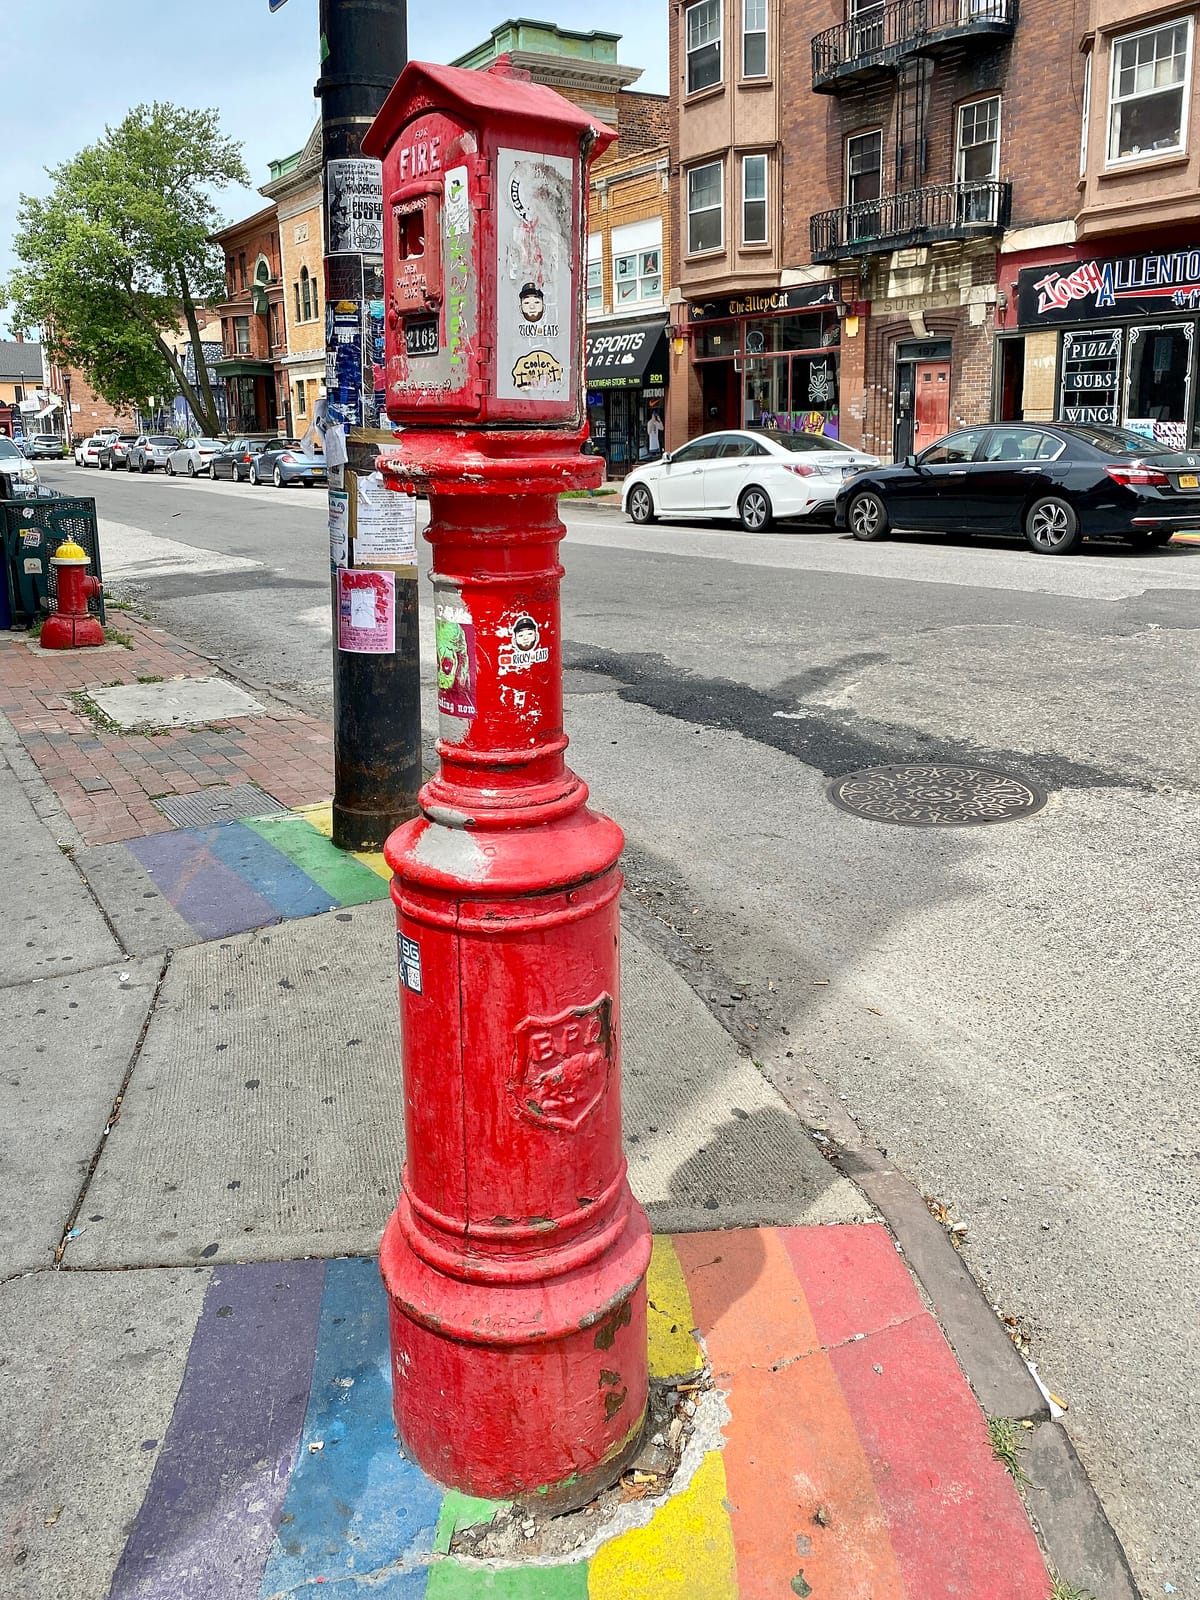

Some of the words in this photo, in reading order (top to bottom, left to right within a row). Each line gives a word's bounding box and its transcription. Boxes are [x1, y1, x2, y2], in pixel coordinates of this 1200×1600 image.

[400, 136, 441, 182] FIRE
[352, 211, 383, 220] OUT
[1033, 260, 1104, 314] JOSH
[1095, 250, 1200, 308] ALLENTO
[729, 300, 744, 314] The
[744, 296, 770, 313] Alley
[770, 292, 789, 309] Cat
[883, 293, 953, 312] SURREY
[406, 327, 436, 348] 2165
[543, 324, 559, 336] EATS
[592, 332, 646, 354] SPORTS
[1071, 340, 1118, 359] PIZZA
[612, 377, 627, 386] STORE
[1073, 373, 1112, 388] SUBS
[1065, 407, 1117, 422] WINGS
[535, 650, 548, 662] EATS
